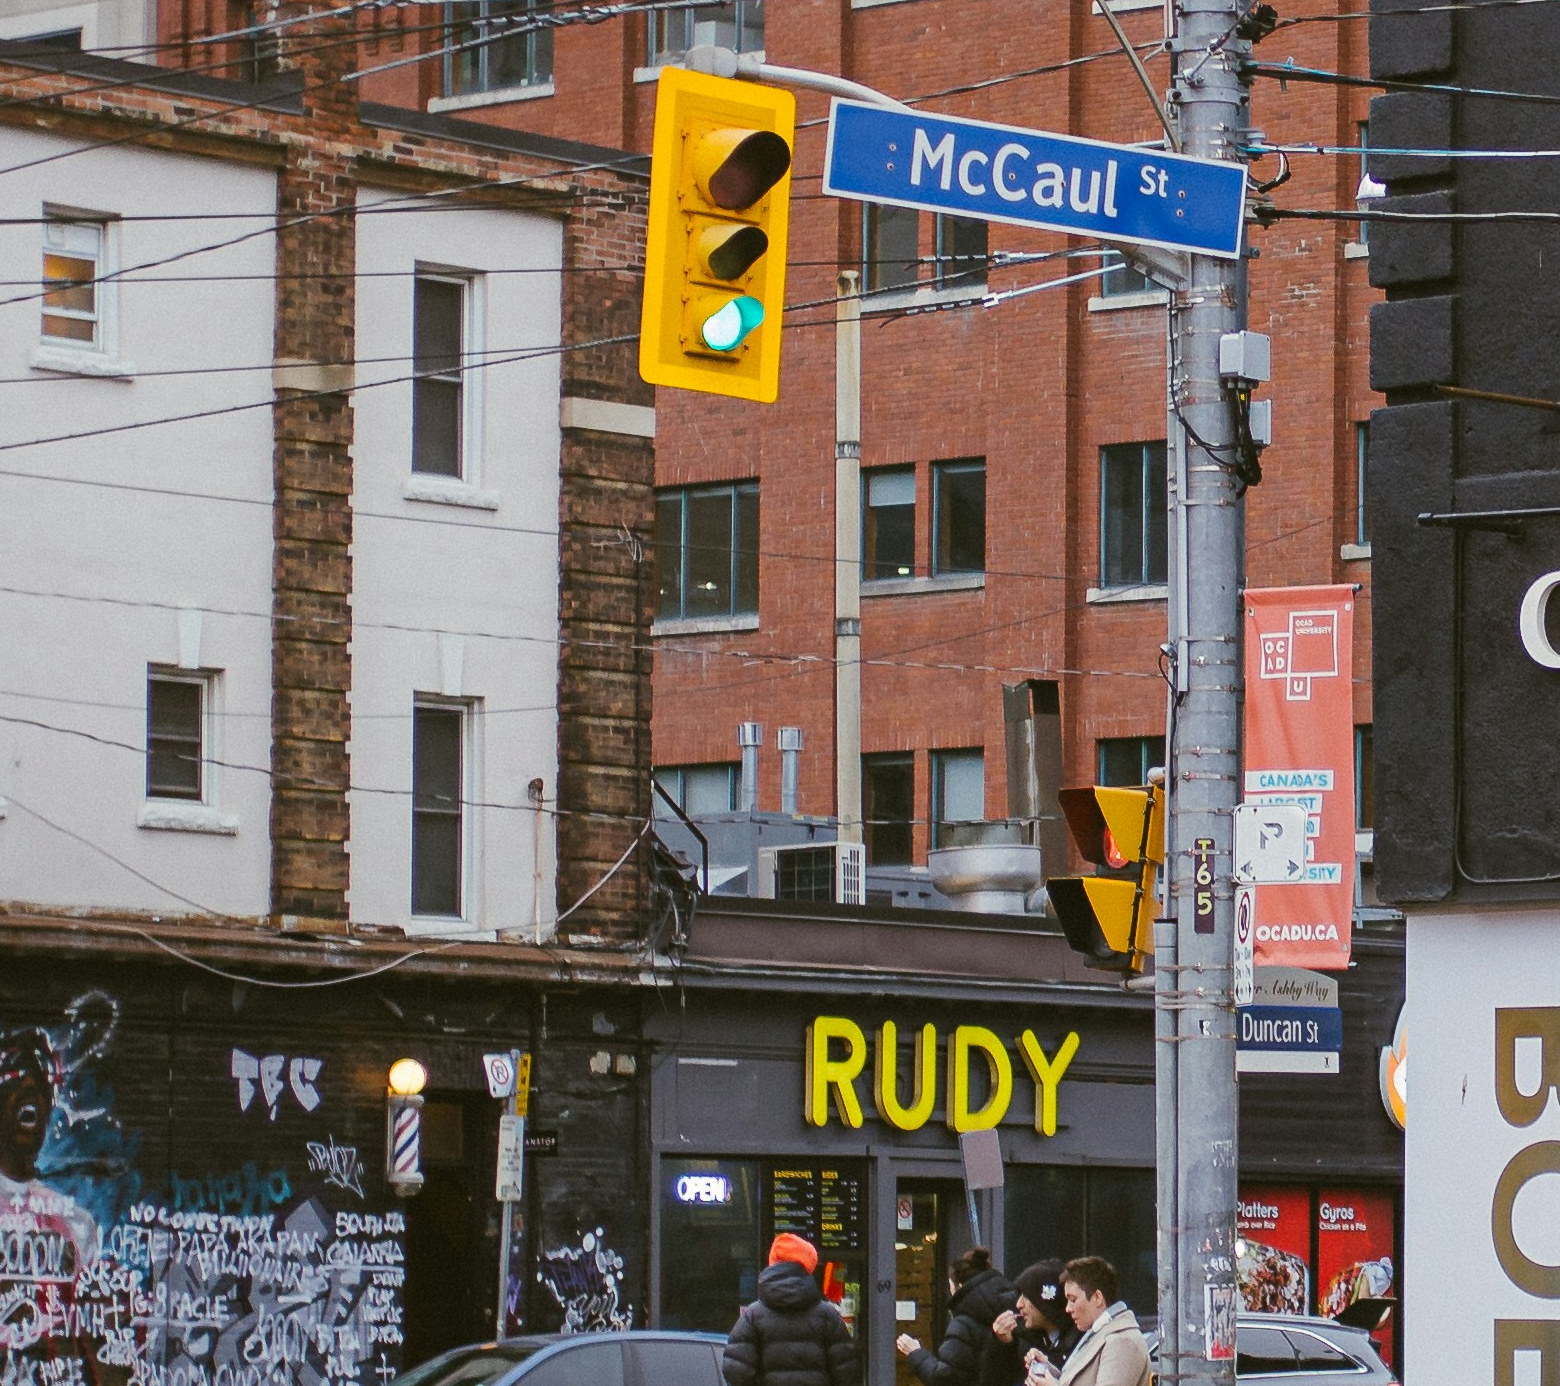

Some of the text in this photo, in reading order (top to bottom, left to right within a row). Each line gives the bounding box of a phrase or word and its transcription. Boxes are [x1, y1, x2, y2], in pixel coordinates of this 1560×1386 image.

[910, 126, 1169, 218] McCaul St
[1259, 773, 1328, 788] CANADA'S
[1196, 839, 1213, 916] T65
[1256, 924, 1339, 942] OCADU.CA
[1242, 1012, 1319, 1044] Duncan St
[804, 1015, 1080, 1138] RUDY
[676, 1175, 729, 1203] OPEN
[1319, 1202, 1354, 1223] Gyros
